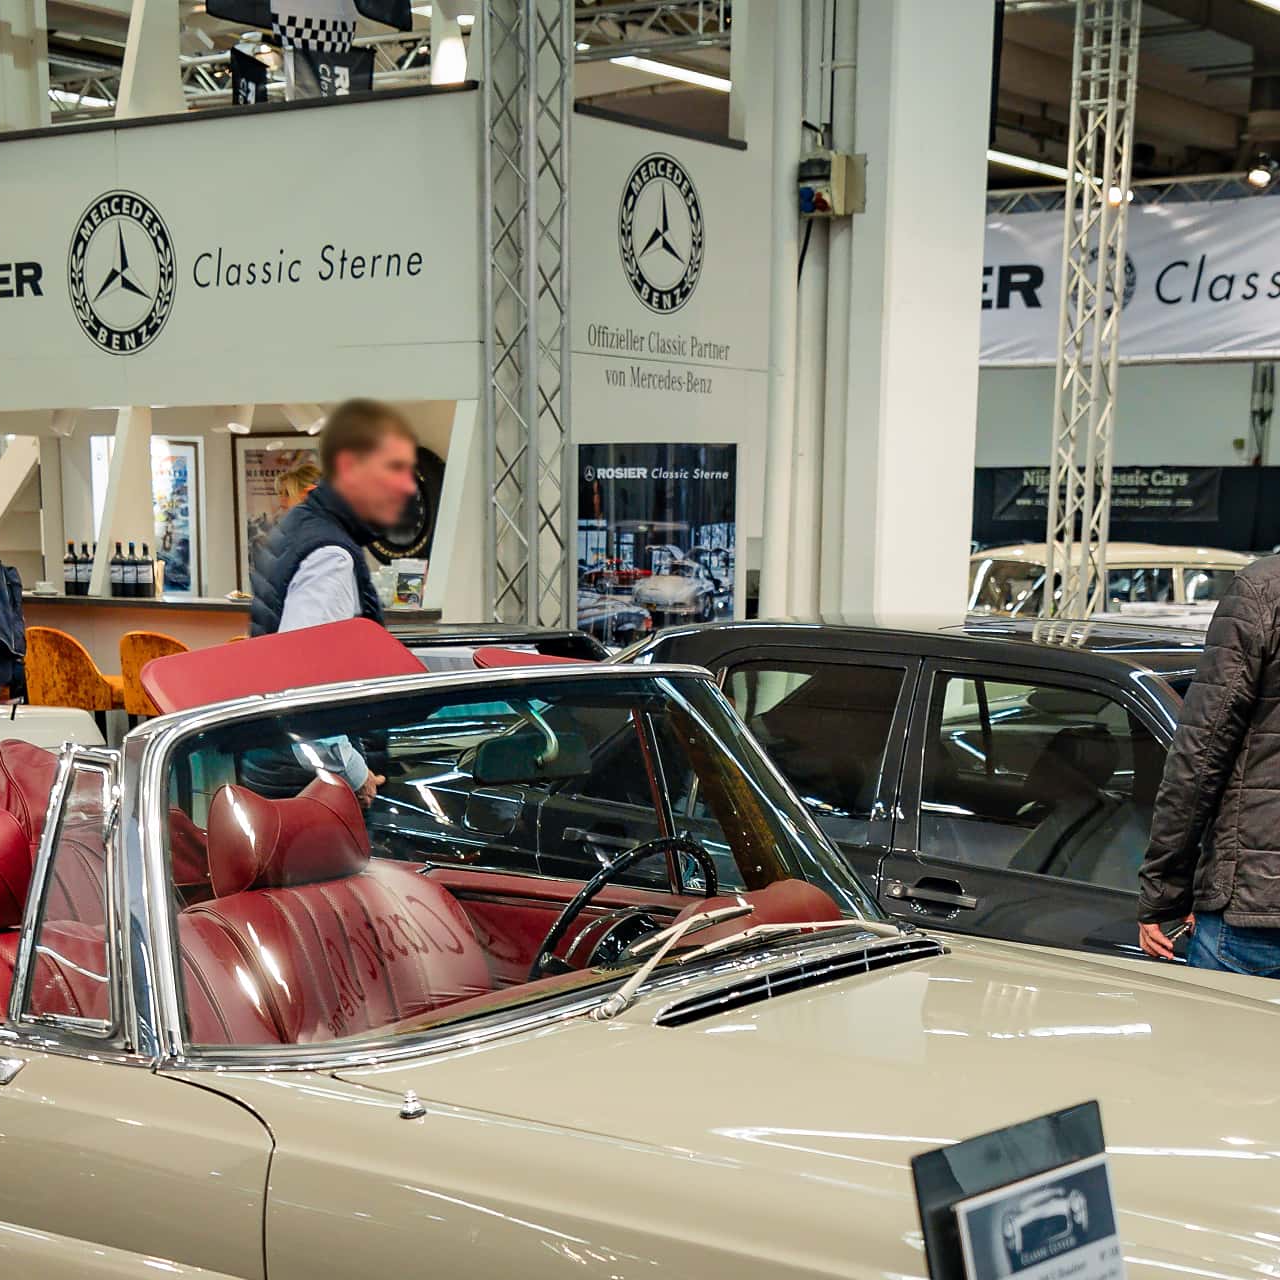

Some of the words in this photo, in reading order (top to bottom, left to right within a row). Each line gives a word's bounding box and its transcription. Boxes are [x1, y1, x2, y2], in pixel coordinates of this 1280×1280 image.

[631, 160, 695, 207] MERCEDES
[79, 197, 161, 241] MERCEDES
[192, 247, 303, 290] Classic
[317, 244, 424, 281] Sterne
[641, 286, 683, 309] BENZ
[96, 323, 151, 350] BENZ
[587, 323, 645, 351] Offizieller
[648, 330, 687, 357] Classic
[690, 336, 731, 361] Partner
[605, 368, 626, 387] von
[630, 366, 713, 394] Mercedes-Benz
[597, 467, 648, 480] ROSIER
[651, 466, 690, 480] Classic
[693, 467, 730, 480] Sterne
[1151, 471, 1189, 486] Cars
